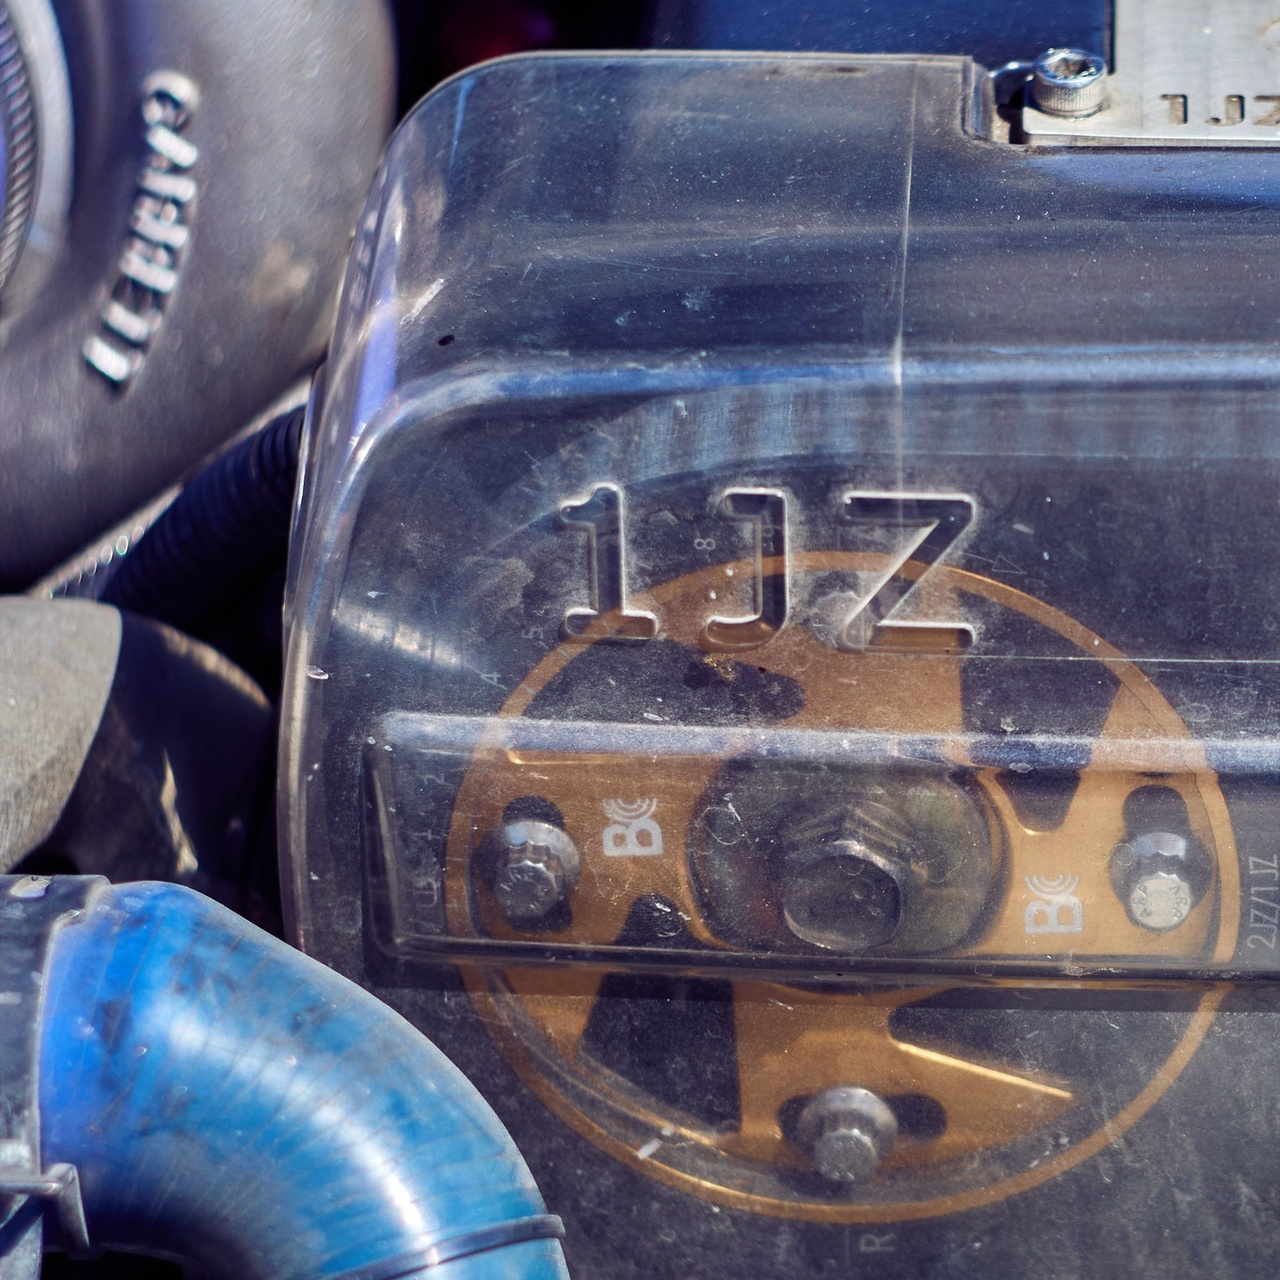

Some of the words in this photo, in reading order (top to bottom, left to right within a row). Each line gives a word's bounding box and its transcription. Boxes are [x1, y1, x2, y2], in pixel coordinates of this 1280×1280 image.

[560, 481, 978, 652] 1JZ
[602, 798, 663, 856] BC
[1024, 875, 1084, 935] BC
